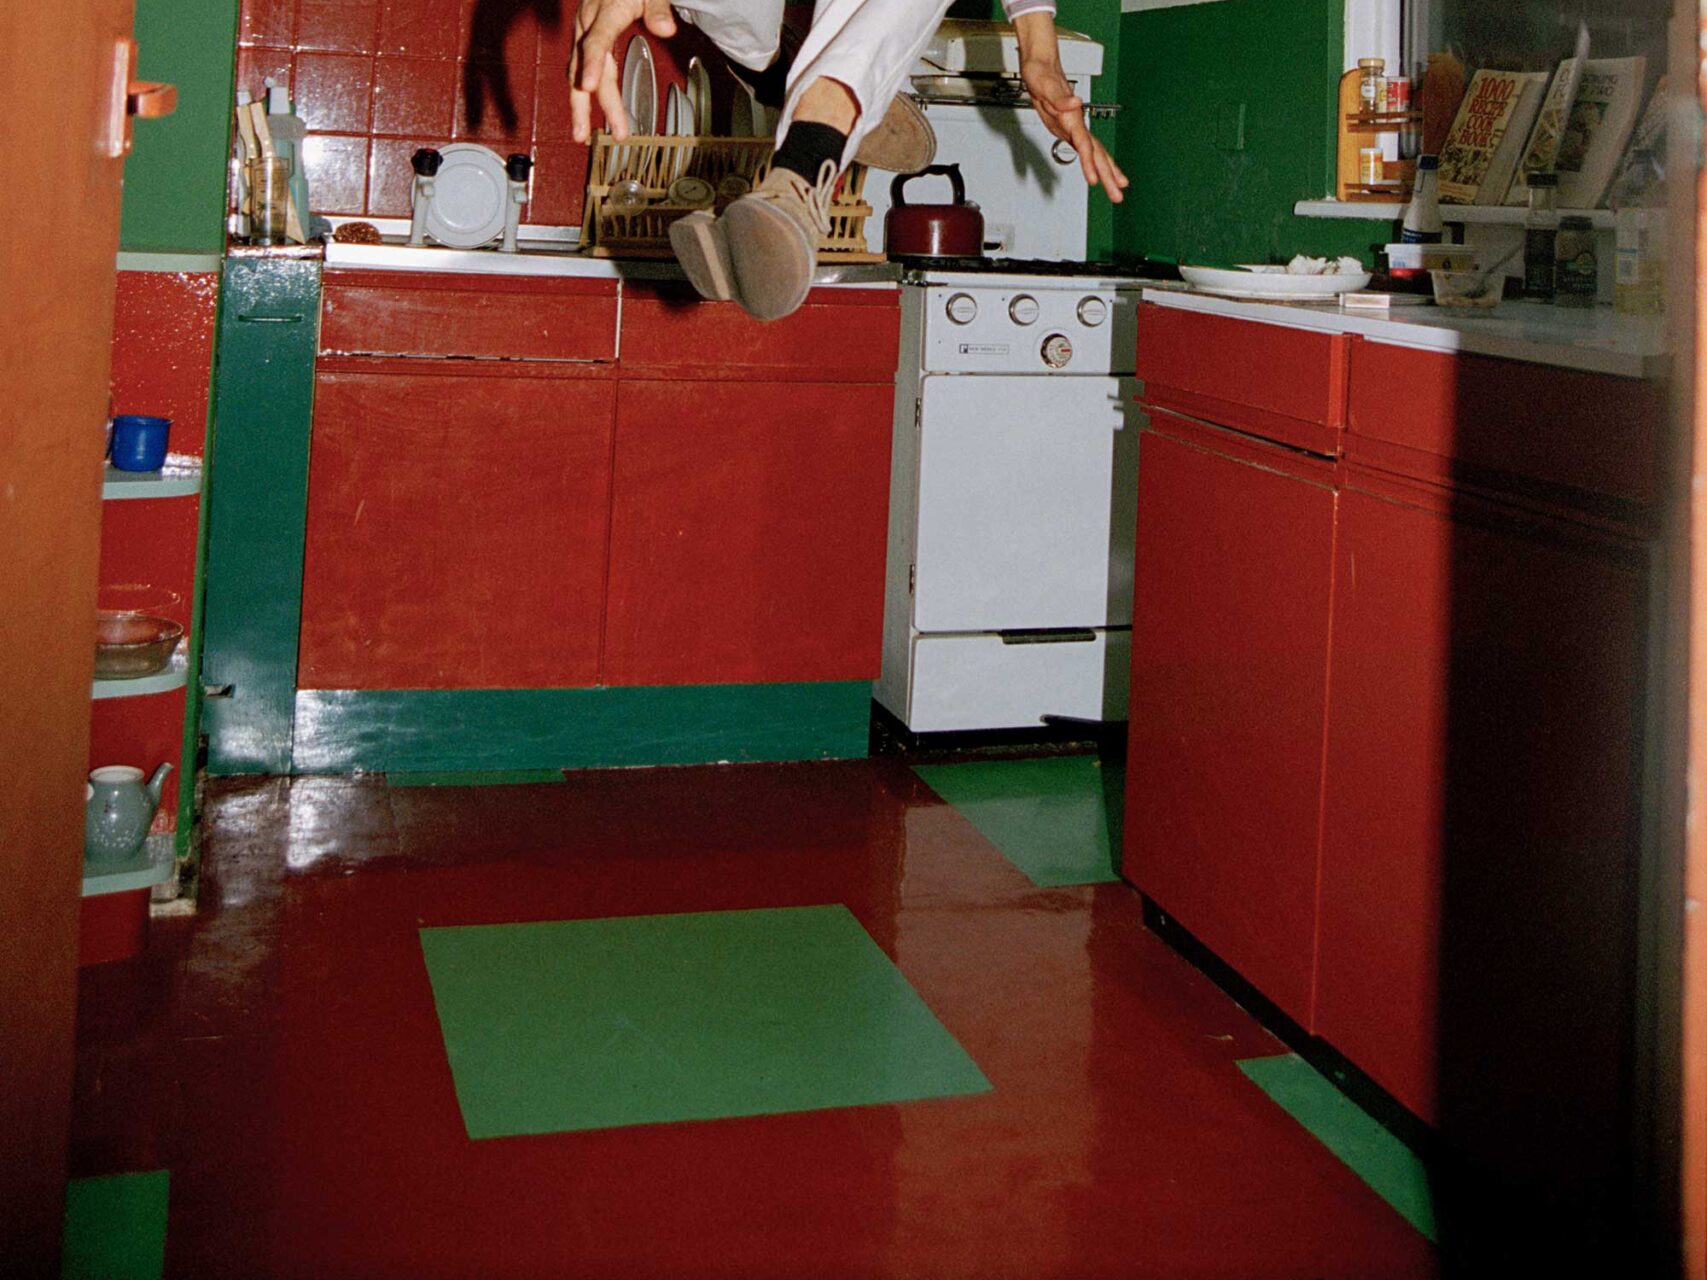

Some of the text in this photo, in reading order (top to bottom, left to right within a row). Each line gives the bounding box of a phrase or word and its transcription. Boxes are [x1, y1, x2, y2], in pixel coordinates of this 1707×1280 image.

[1476, 77, 1515, 100] 1000
[1468, 98, 1508, 117] RECIPE
[1466, 114, 1496, 132] COOK
[1459, 129, 1491, 147] BOOK
